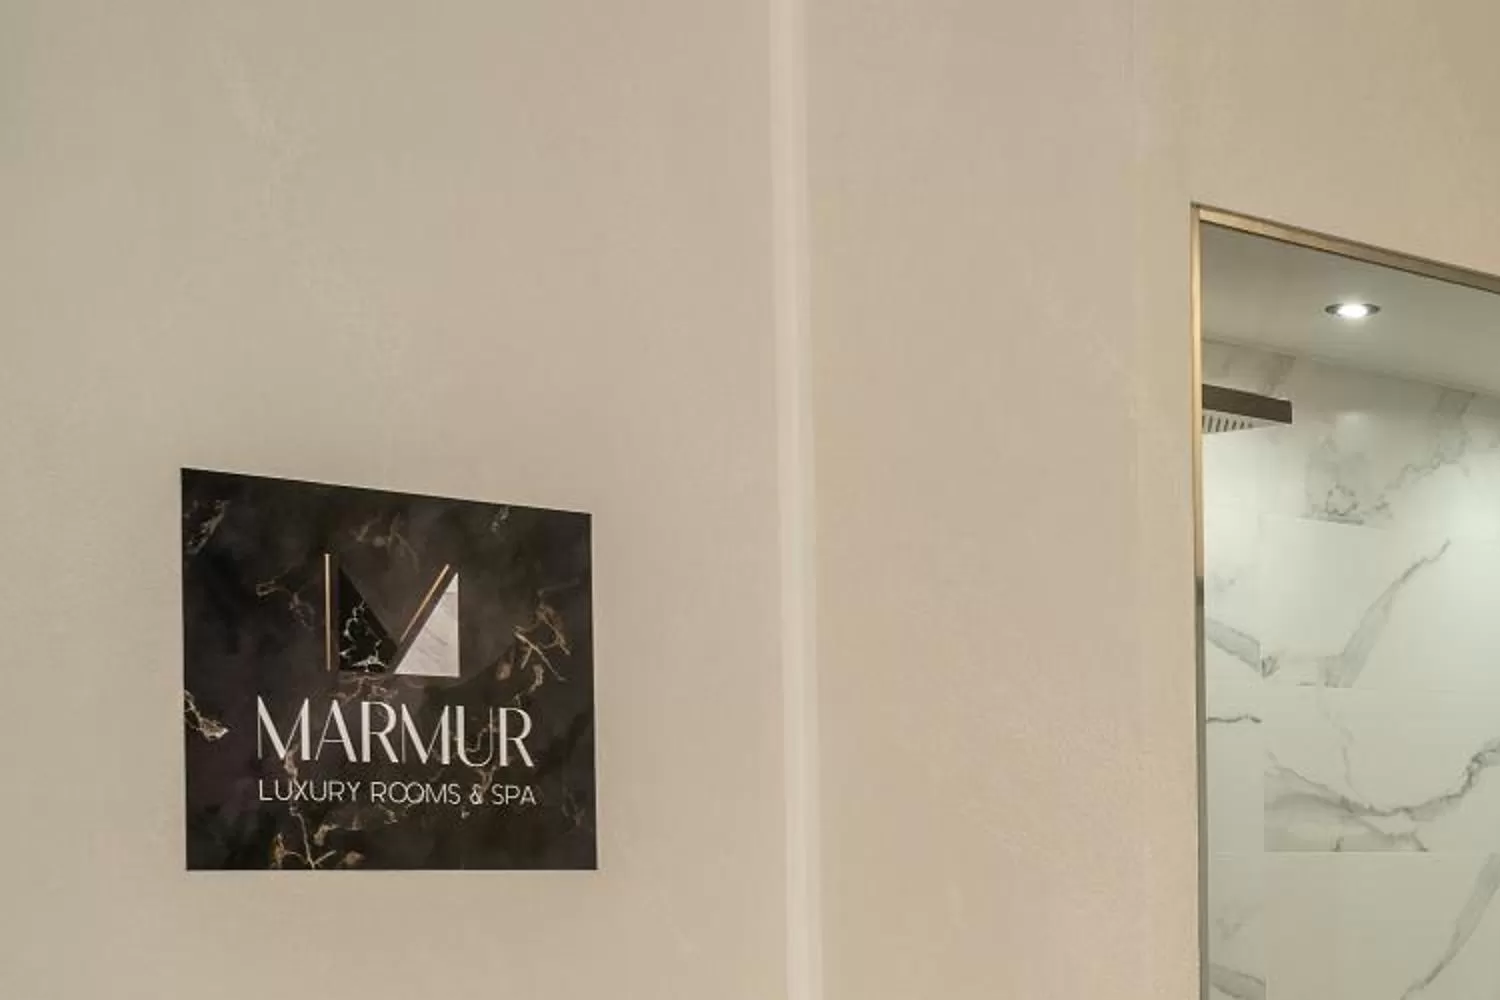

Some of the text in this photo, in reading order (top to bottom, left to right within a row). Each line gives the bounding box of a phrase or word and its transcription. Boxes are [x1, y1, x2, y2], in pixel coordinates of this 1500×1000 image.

[256, 695, 535, 768] MARMUR
[258, 779, 537, 805] LUXURY ROOMS & SPA
